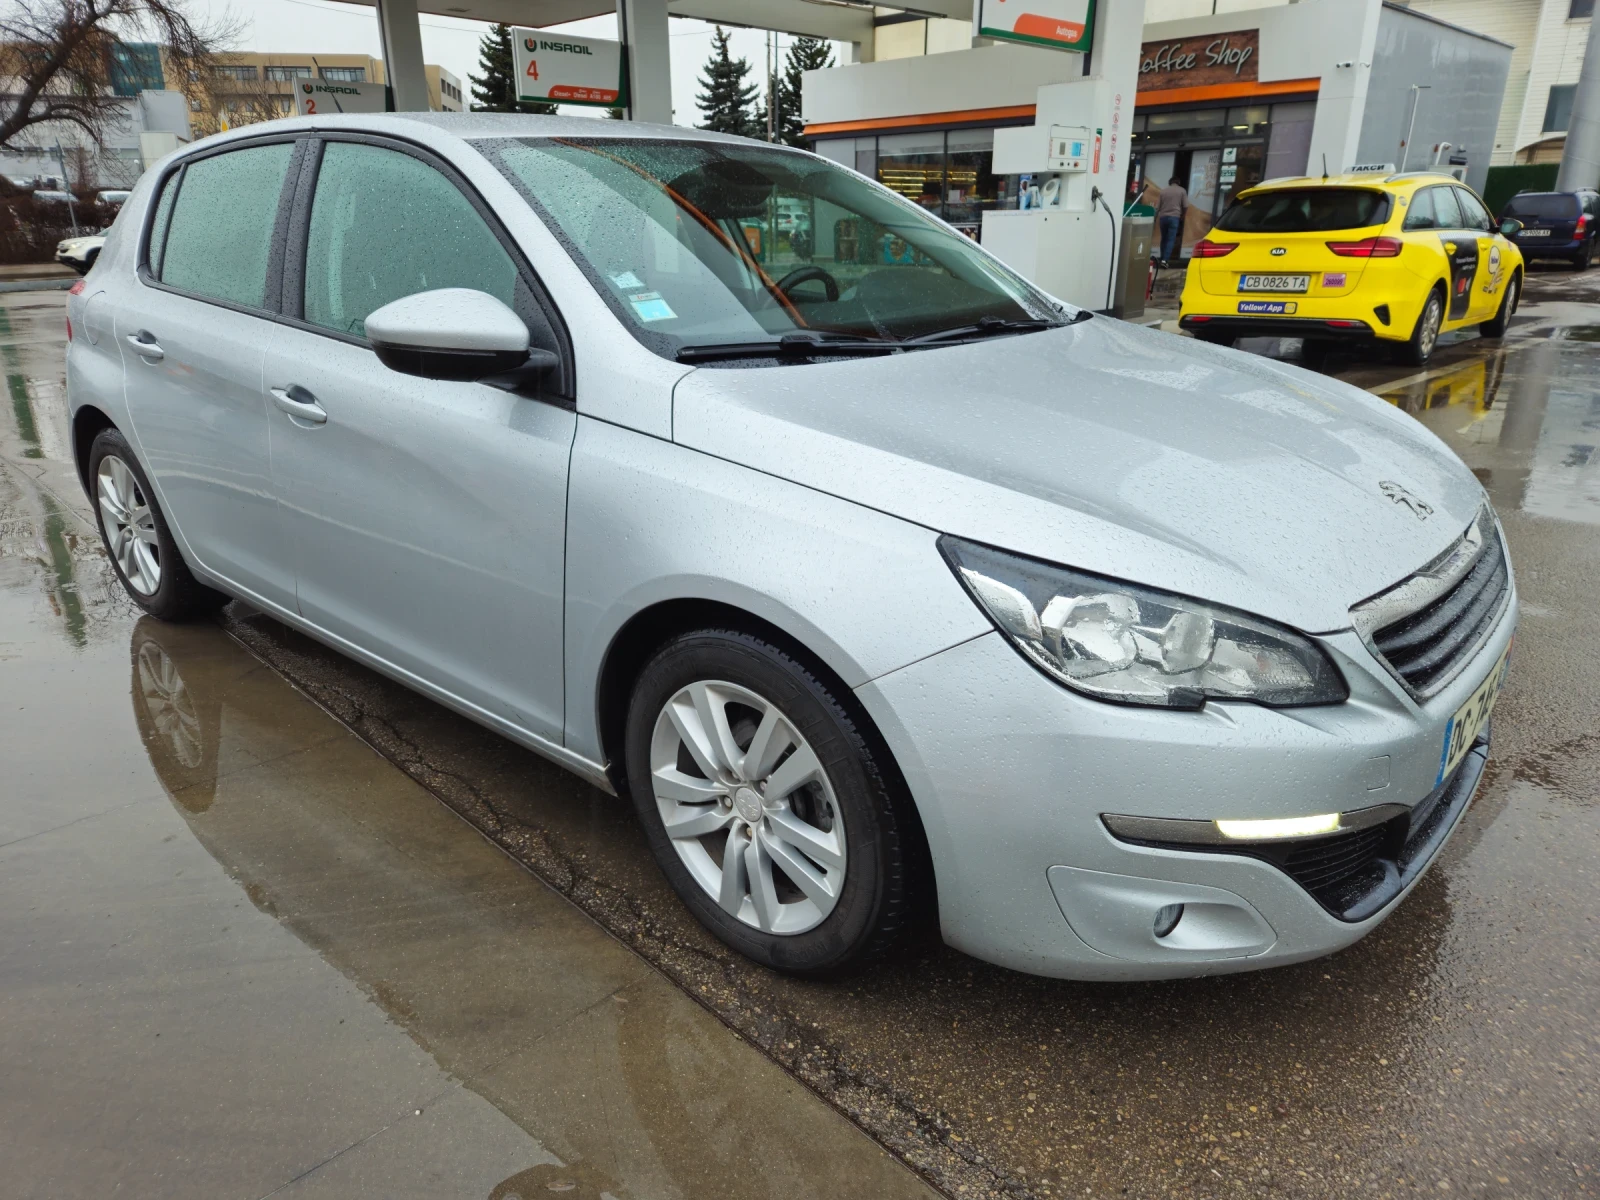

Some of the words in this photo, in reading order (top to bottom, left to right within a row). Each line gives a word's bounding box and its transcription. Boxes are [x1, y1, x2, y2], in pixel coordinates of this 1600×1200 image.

[1056, 25, 1078, 38] Autogas
[540, 40, 593, 55] INSAOIL
[1205, 38, 1253, 75] Shop
[526, 60, 539, 81] 4
[315, 85, 361, 95] INSAOIL
[305, 99, 317, 114] 2
[1246, 277, 1261, 288] CB
[1262, 277, 1289, 288] 0826
[1292, 277, 1306, 288] TA
[1267, 304, 1283, 312] App
